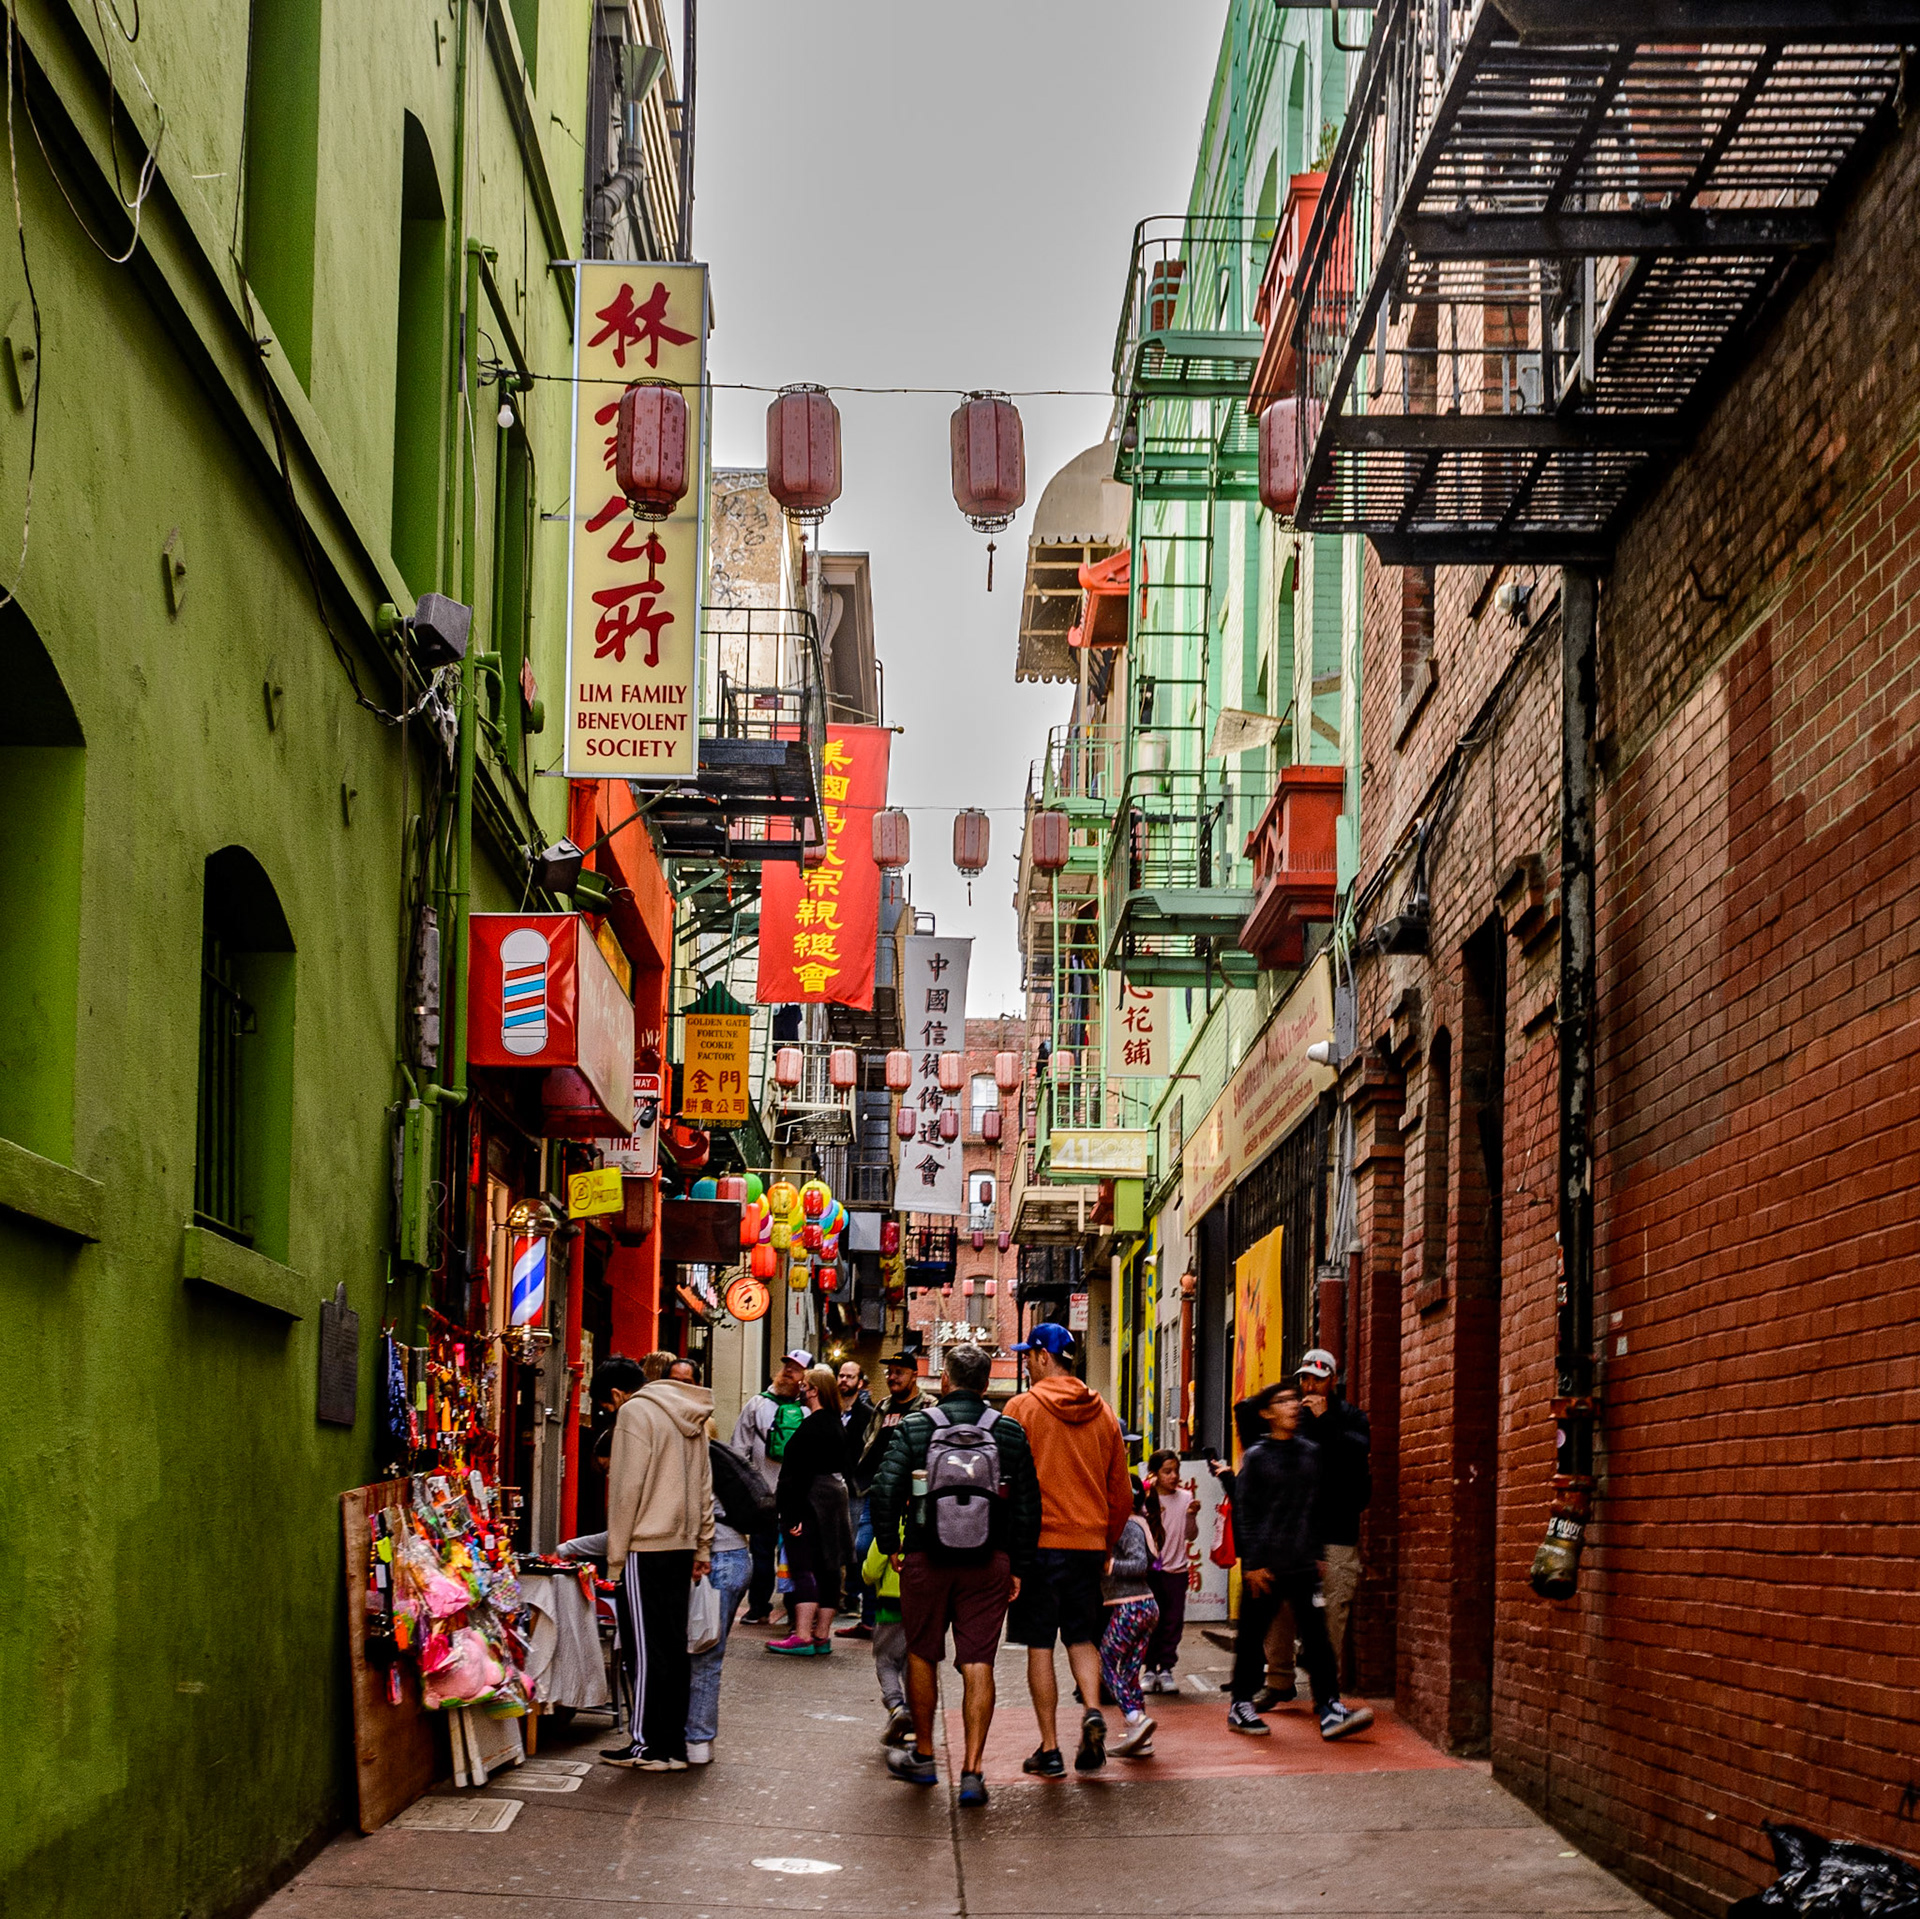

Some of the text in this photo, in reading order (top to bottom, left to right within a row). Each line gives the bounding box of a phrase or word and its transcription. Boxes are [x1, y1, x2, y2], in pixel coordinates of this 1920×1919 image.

[585, 281, 698, 668] 林公所
[579, 683, 687, 704] LIM FAMILY
[577, 712, 688, 731] BENEVOLENT
[586, 738, 677, 758] SOCIETY
[687, 1018, 748, 1027] GOLDEN GATE
[697, 1030, 738, 1038] FORTUNE
[700, 1041, 734, 1049] COOKIE
[697, 1052, 736, 1061] FACTORY
[690, 1069, 740, 1094] 金門
[1056, 1138, 1090, 1168] 41
